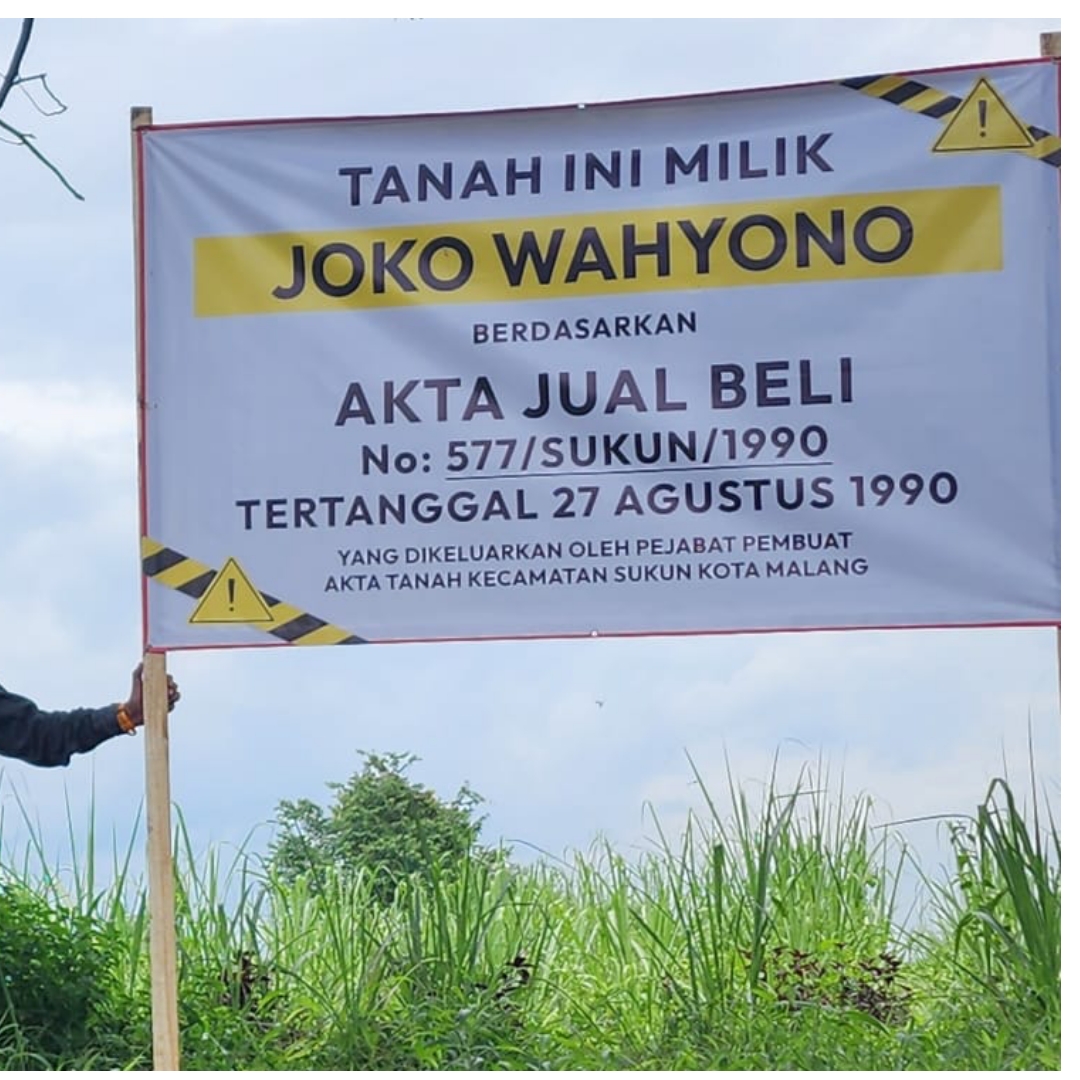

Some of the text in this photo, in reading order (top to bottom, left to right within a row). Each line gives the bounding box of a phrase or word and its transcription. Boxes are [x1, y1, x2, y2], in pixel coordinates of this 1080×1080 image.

[339, 132, 834, 206] TANAH INI MILIK
[272, 205, 914, 301] JOKO WAHYONO
[472, 311, 698, 345] BERDASARKAN
[335, 356, 854, 427] AKTA JUAL BELI
[361, 424, 828, 476] No: 577/SUKUN/1990
[235, 471, 958, 530] TERTANGGAL 27 AGUSTUS 1990
[324, 557, 869, 593] AKTA TANAH KECAMATAN SUKUN KOTA MALANG
[337, 531, 854, 567] YANG DIKELUARKAN OLEH PEJABAT PEMBUAT
